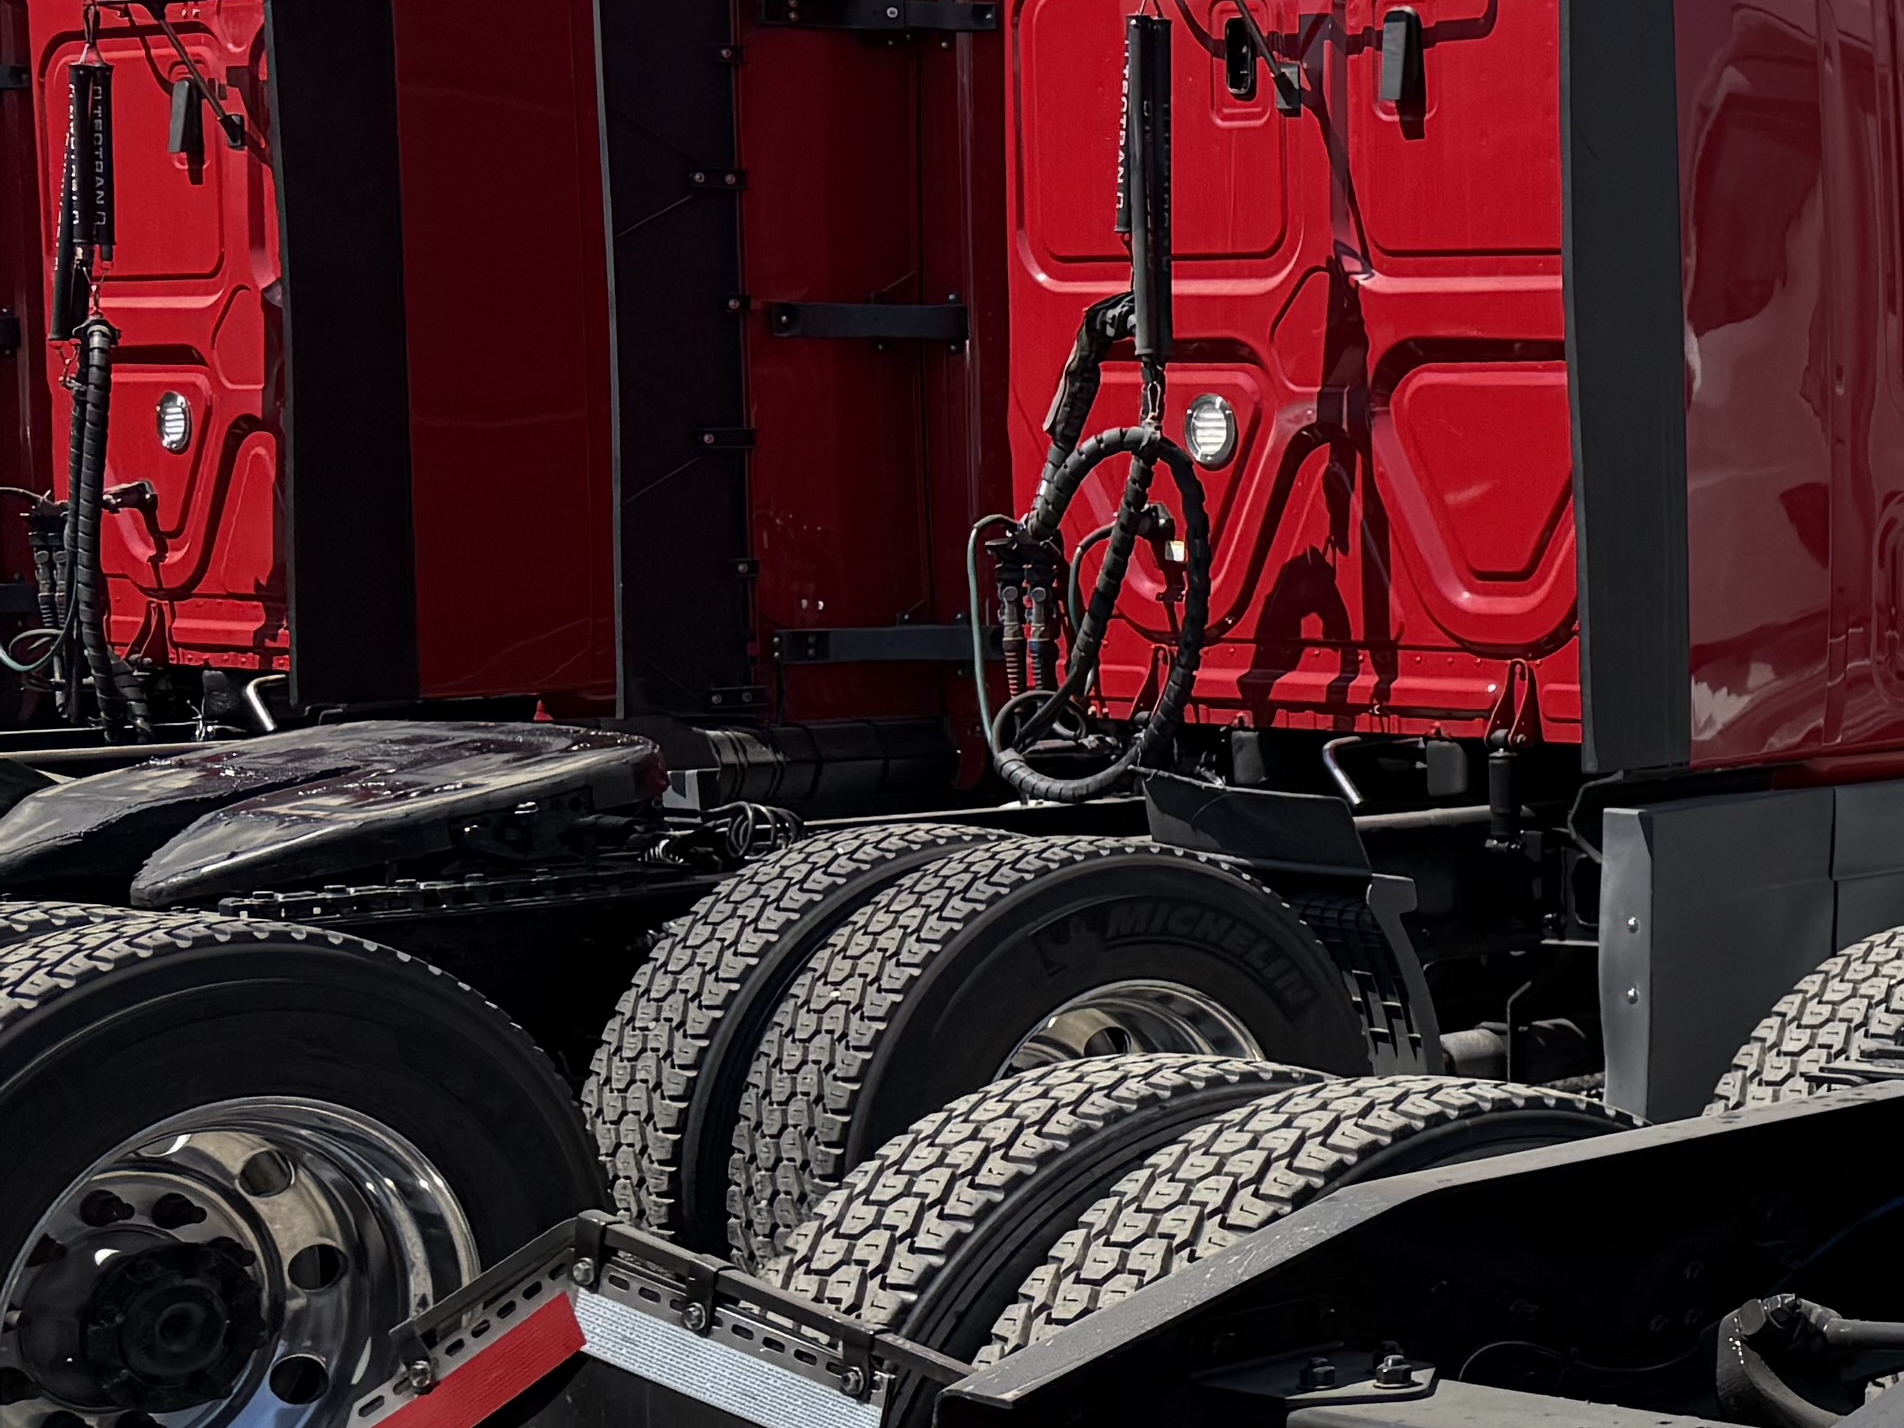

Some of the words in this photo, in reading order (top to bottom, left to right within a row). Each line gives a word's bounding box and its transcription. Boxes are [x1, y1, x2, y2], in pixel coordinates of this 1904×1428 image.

[92, 105, 105, 205] TECTRAN
[1115, 64, 1129, 187] TECTRAN
[1105, 902, 1319, 1012] MICHELIN
